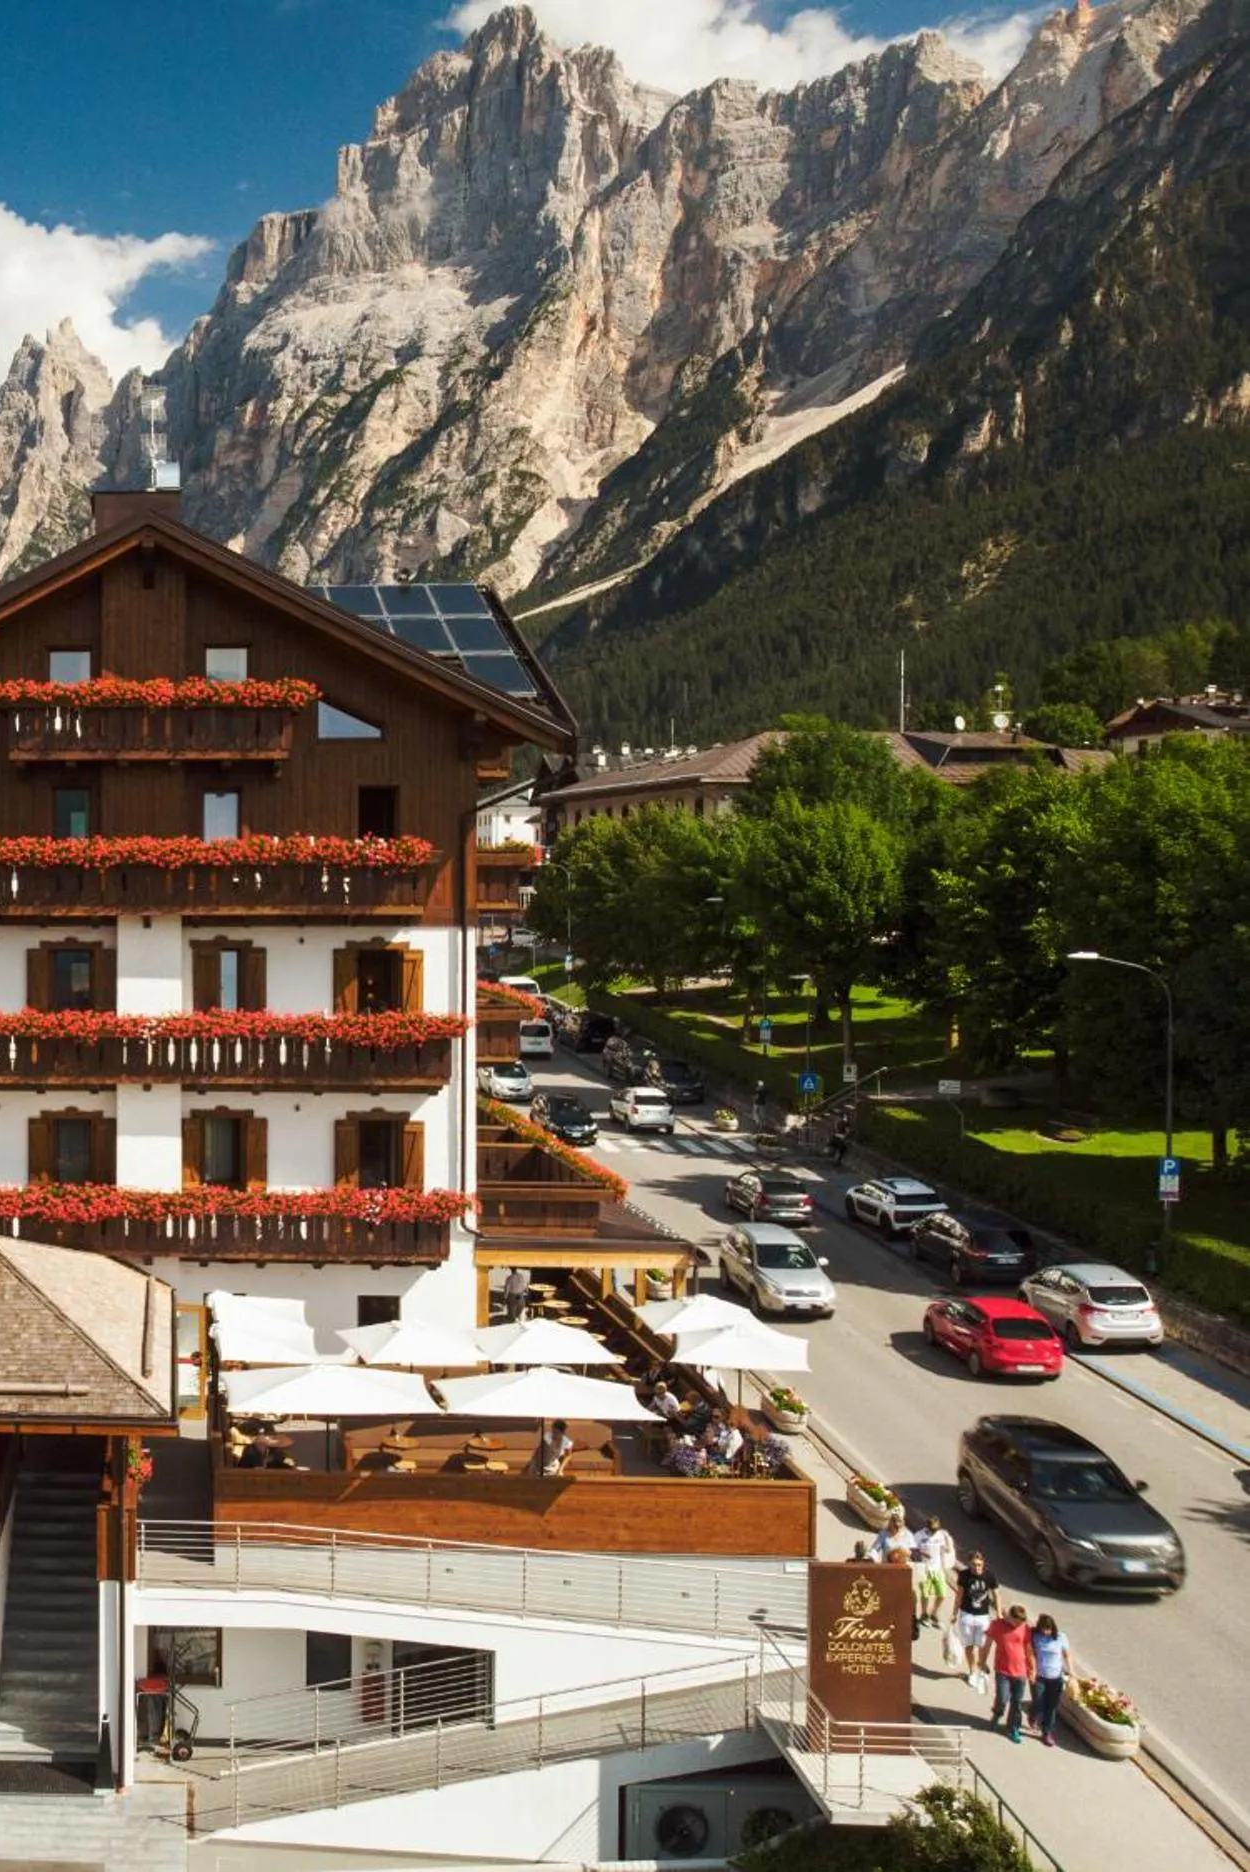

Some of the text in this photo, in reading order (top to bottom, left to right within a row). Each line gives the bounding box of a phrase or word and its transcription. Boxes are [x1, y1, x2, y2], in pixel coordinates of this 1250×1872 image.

[1164, 1159, 1176, 1173] P
[828, 1616, 895, 1640] Fiori
[828, 1641, 894, 1653] DOLOMITES
[825, 1652, 897, 1664] EXPERIENCE
[841, 1664, 879, 1675] HOTEL
